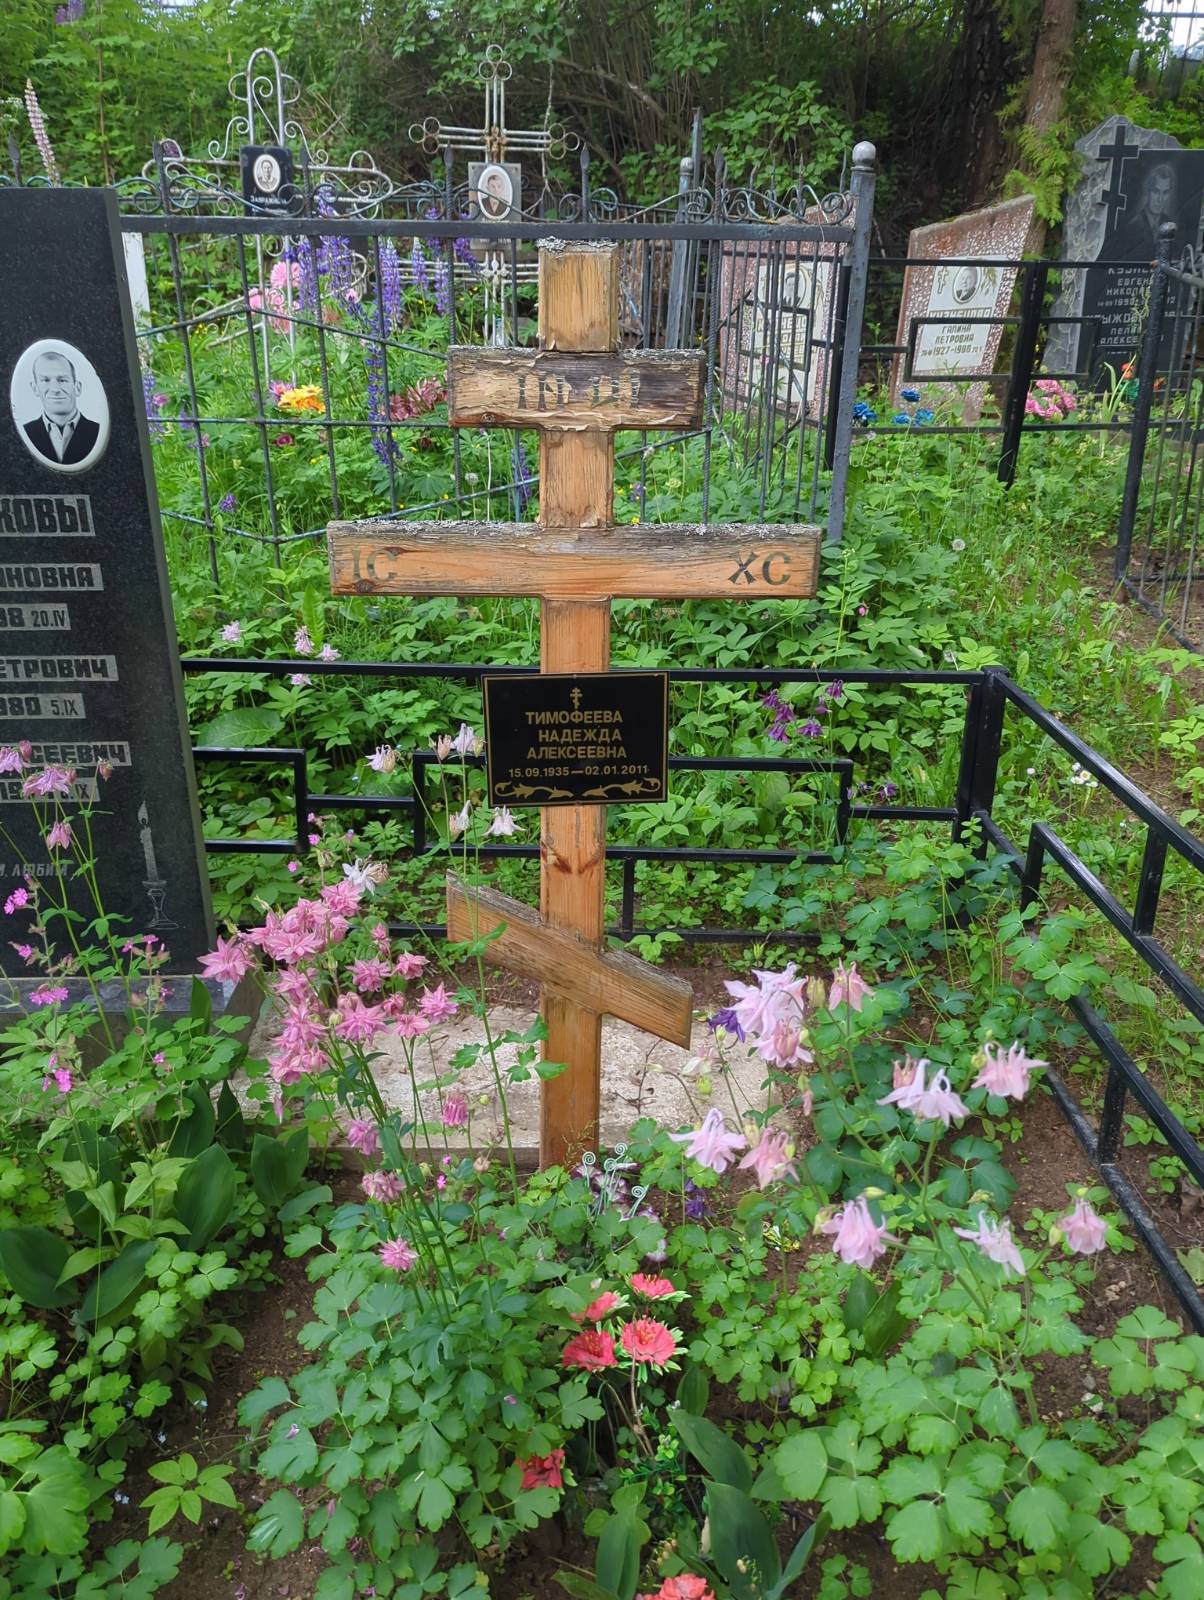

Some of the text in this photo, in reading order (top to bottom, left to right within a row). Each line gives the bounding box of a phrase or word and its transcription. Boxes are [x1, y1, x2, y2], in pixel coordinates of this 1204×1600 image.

[525, 709, 624, 725] ТИМОФЕЕВА
[538, 728, 623, 744] НАДЕЖДА
[526, 745, 628, 760] АЛЕКСЕЕВНА
